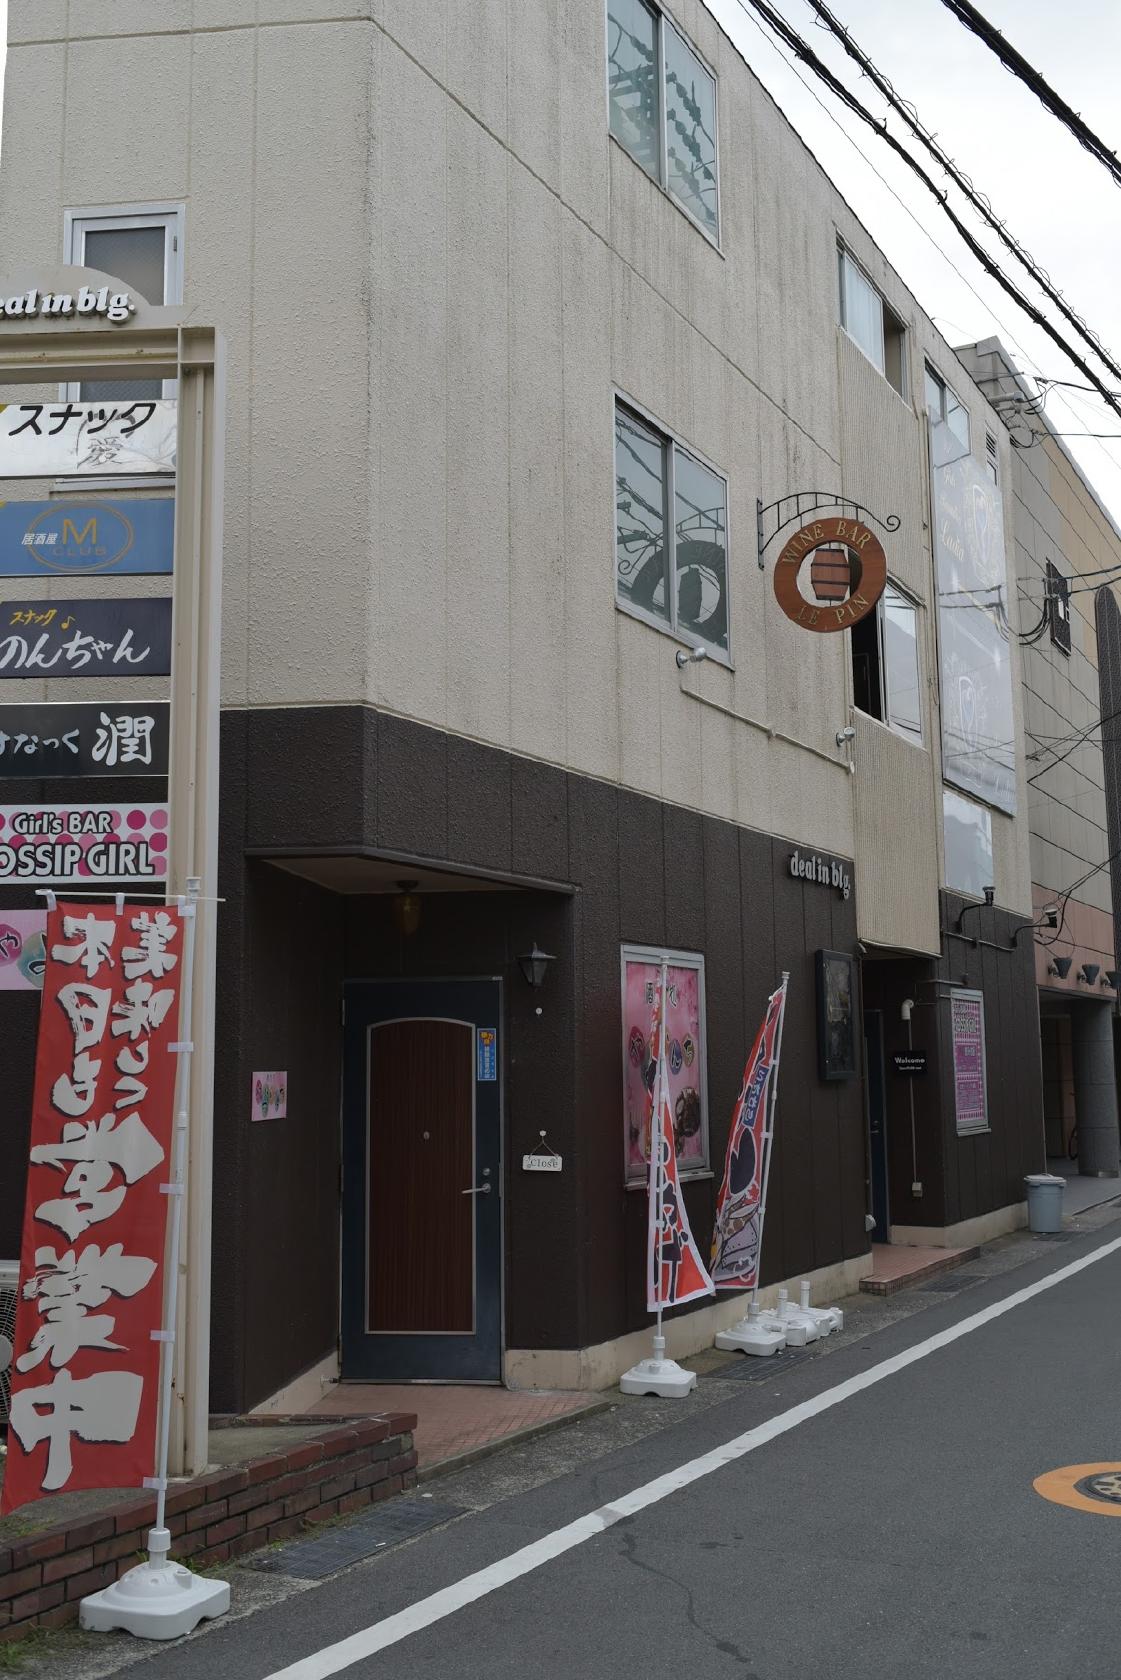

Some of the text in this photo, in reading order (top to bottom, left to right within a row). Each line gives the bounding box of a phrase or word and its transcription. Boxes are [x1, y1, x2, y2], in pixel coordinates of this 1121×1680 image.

[41, 292, 72, 315] in
[77, 286, 136, 325] blg.
[9, 402, 156, 436] スナック
[21, 517, 97, 545] 居酒屋 M
[782, 520, 871, 563] WINE BAR
[9, 609, 57, 626] スナック
[797, 594, 870, 625] LE PIN
[0, 628, 151, 669] のんちゃん
[91, 711, 155, 766] 潤
[13, 811, 112, 836] Girl's BAR
[87, 841, 155, 877] GIRL
[790, 850, 816, 881] deal
[817, 857, 830, 885] in
[530, 1158, 560, 1169] Close
